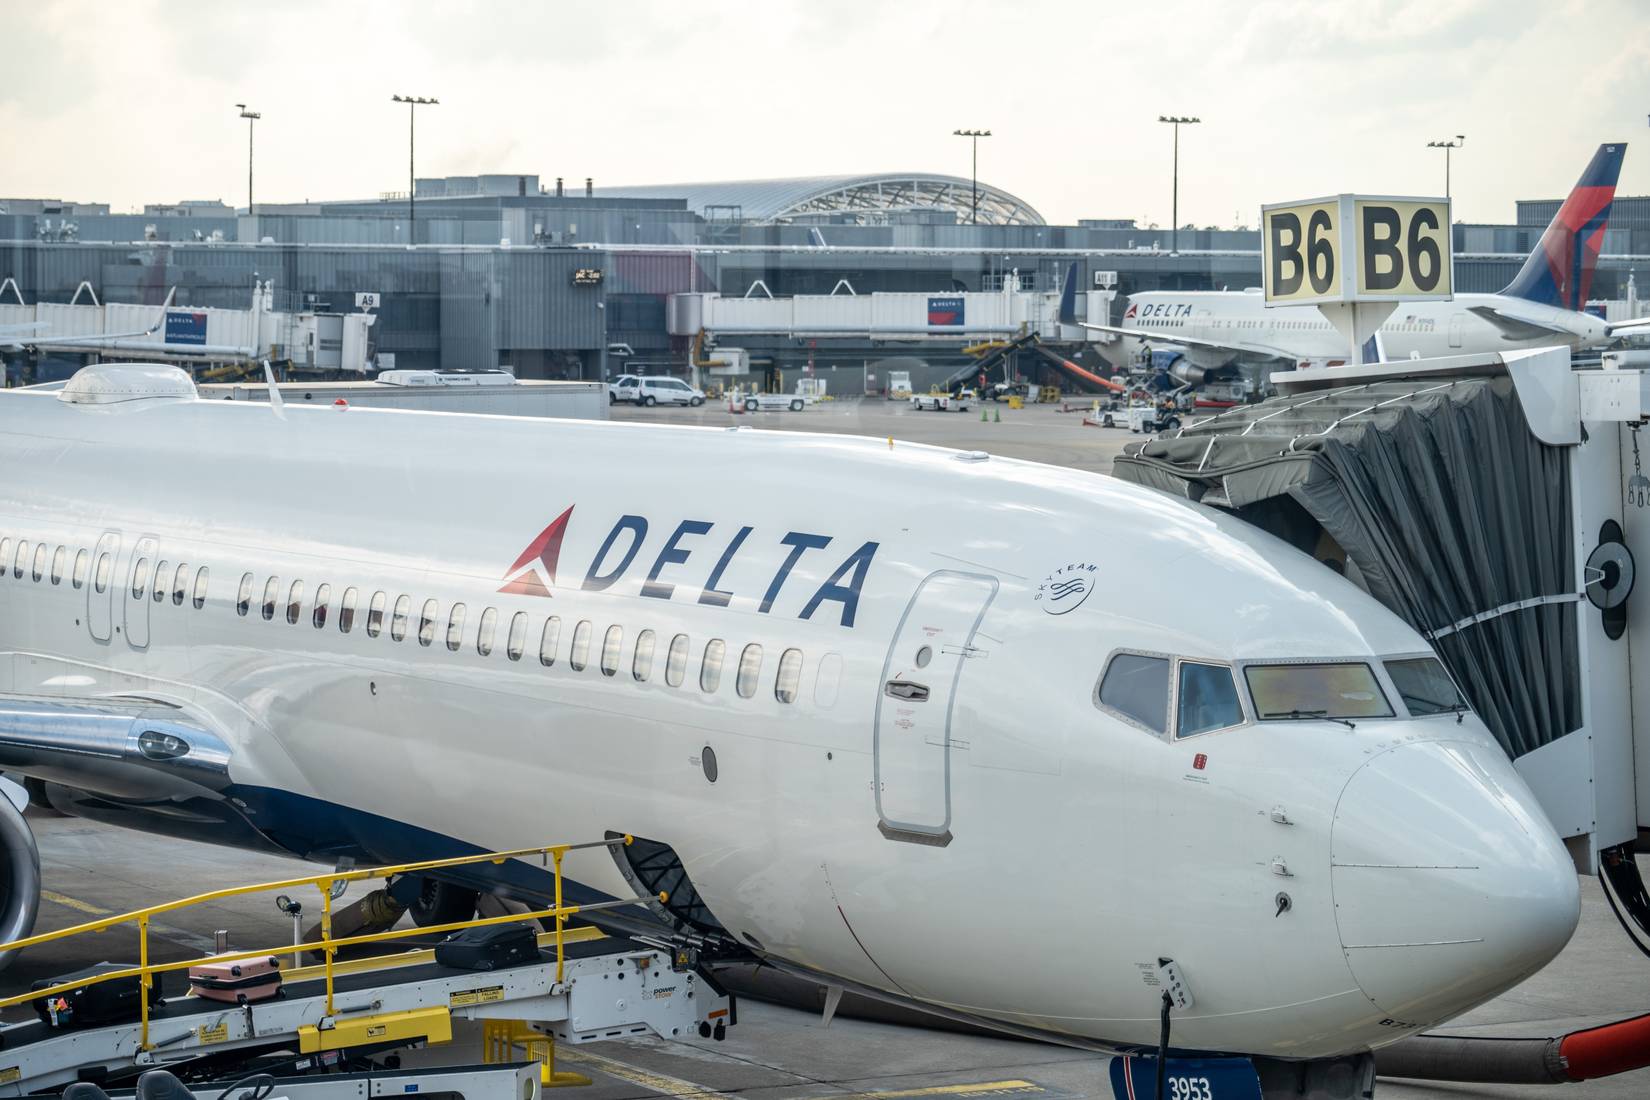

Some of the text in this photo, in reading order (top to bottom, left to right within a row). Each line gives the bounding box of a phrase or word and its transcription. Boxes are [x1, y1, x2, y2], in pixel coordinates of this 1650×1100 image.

[1271, 209, 1335, 296] B6
[1362, 206, 1441, 292] B6
[362, 295, 374, 306] A9
[1142, 304, 1193, 317] DELTA
[581, 514, 880, 628] DELTA
[1034, 563, 1097, 601] SKYTEAM
[653, 986, 677, 995] power
[1168, 1076, 1213, 1100] 3953
